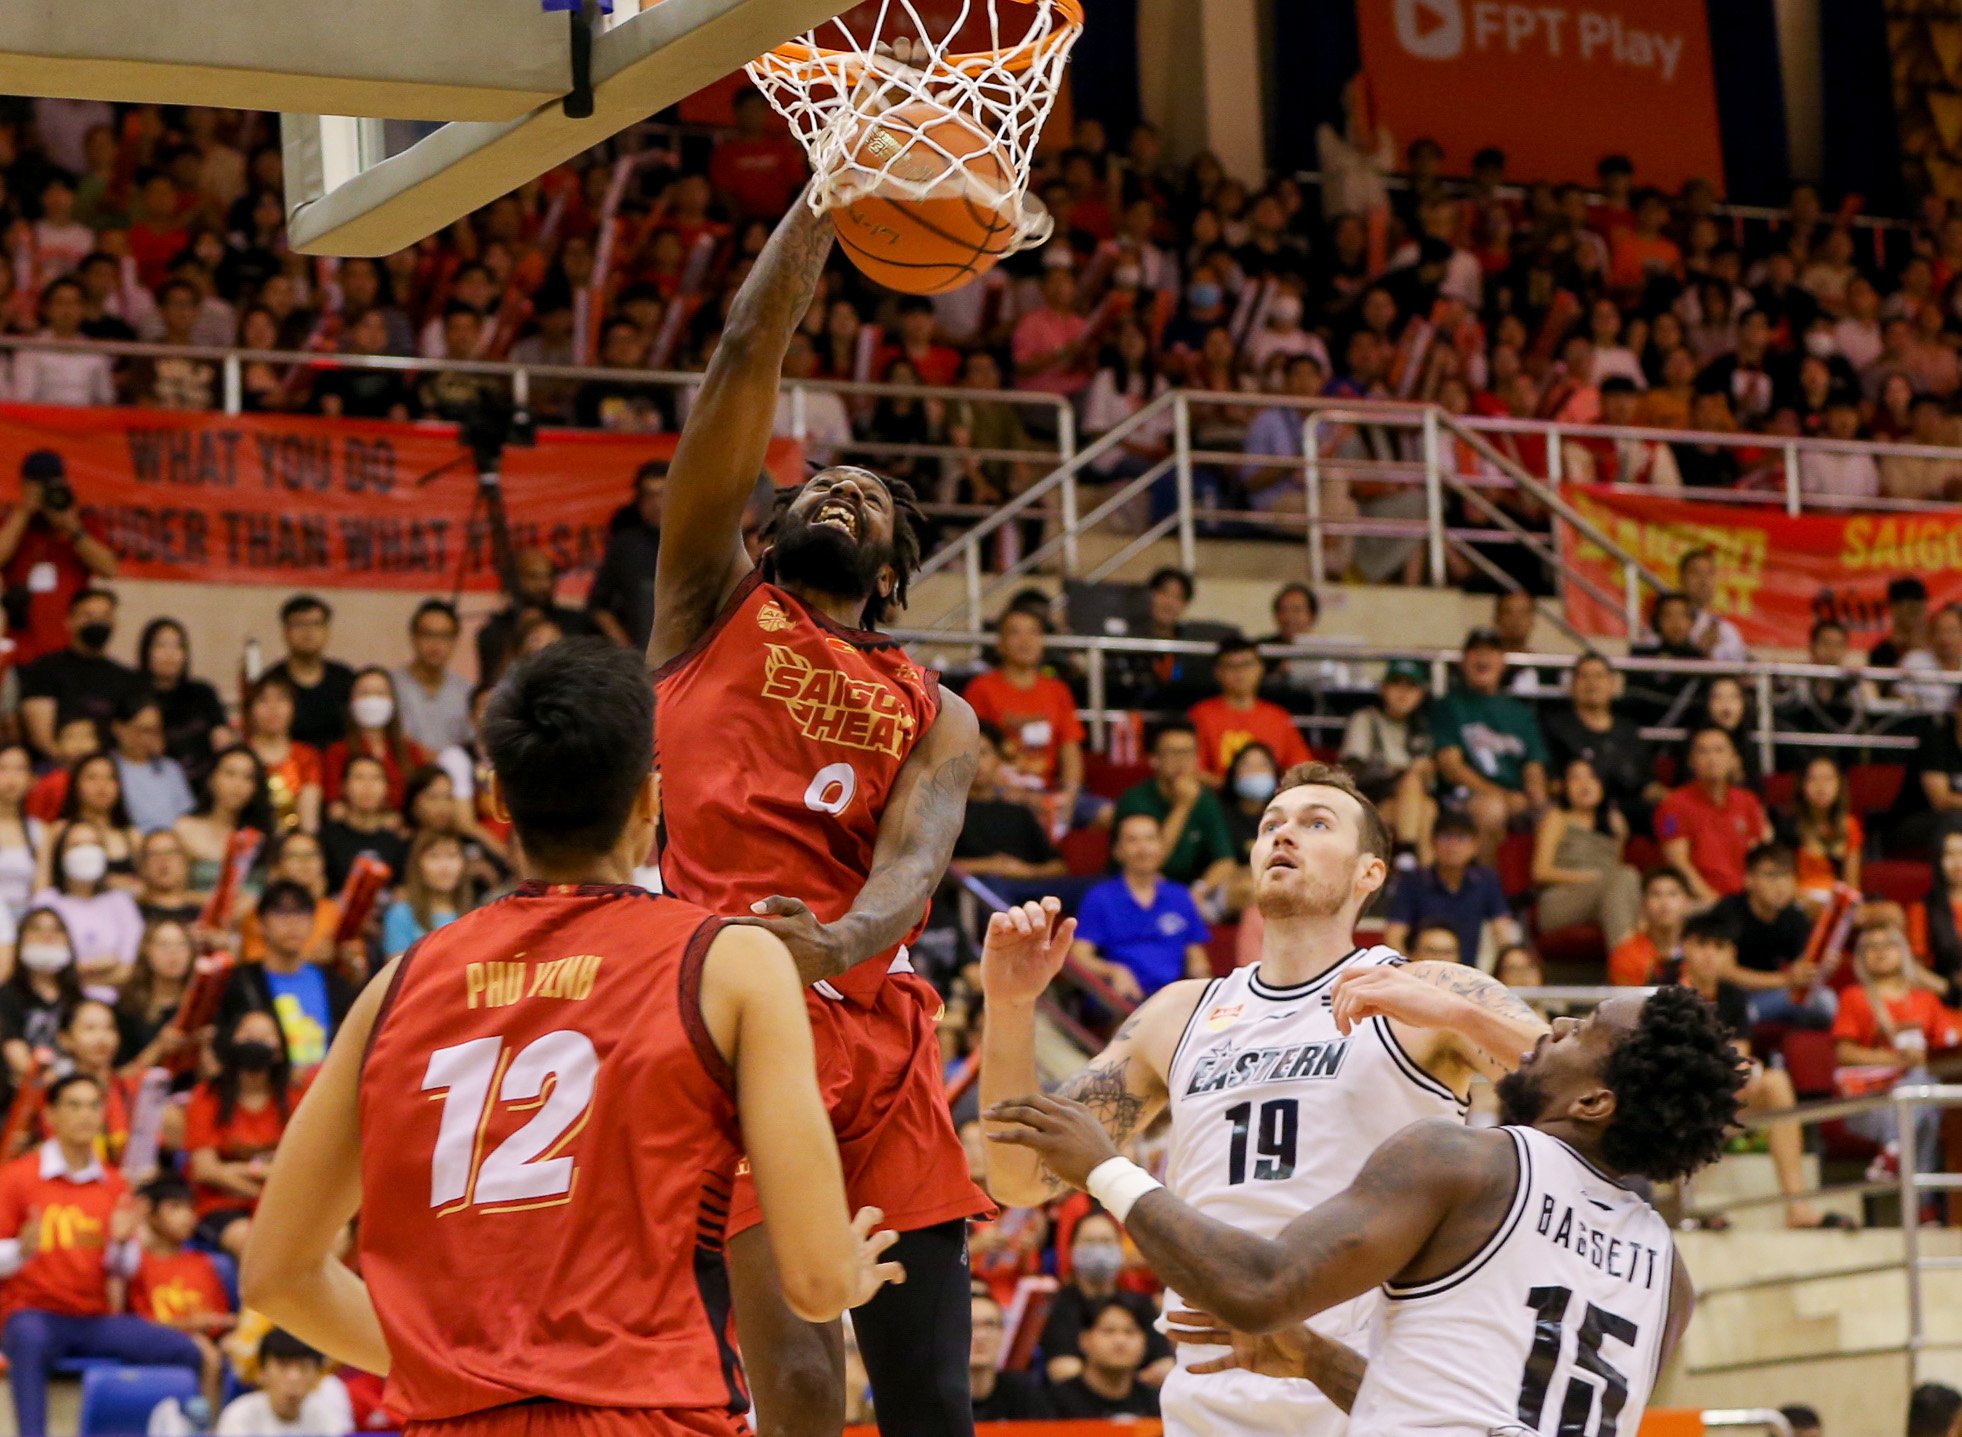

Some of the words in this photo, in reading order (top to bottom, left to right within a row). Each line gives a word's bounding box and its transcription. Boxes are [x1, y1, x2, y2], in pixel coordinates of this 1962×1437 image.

[1473, 2, 1567, 57] FPT
[1580, 10, 1682, 82] Play
[127, 428, 242, 488] WHAT
[255, 432, 333, 492] YOU
[343, 434, 398, 495] DO
[221, 509, 329, 570] THAN
[339, 515, 449, 574] WHAT
[1183, 1040, 1353, 1100] EASTERN
[421, 1029, 602, 1216] 12
[1225, 1098, 1299, 1186] 19
[1536, 1192, 1659, 1290] BASSETT
[1516, 1285, 1639, 1437] 15
